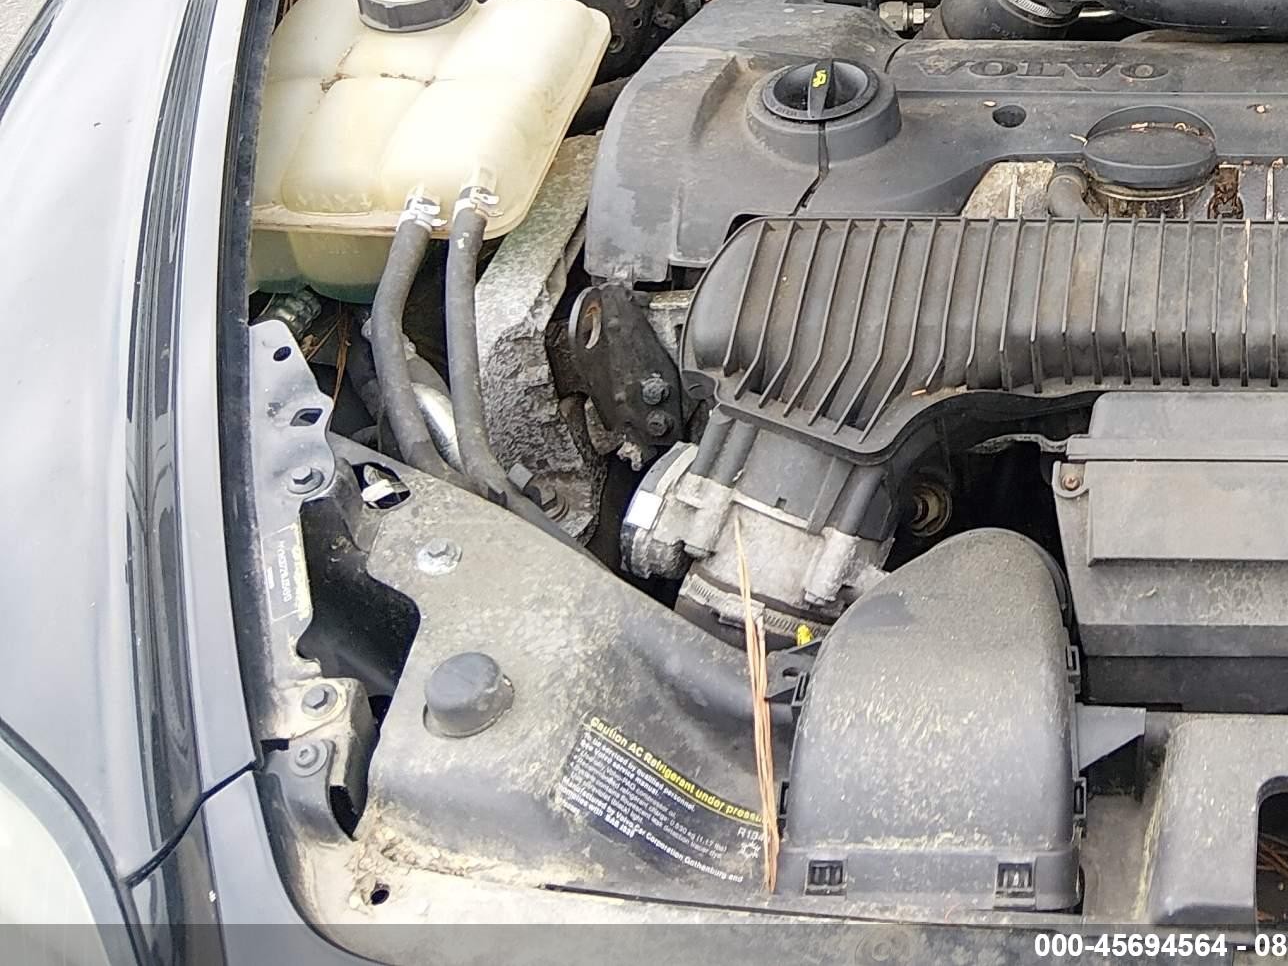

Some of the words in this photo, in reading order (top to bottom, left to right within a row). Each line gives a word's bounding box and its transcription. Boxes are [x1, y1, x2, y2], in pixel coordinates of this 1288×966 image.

[914, 60, 1169, 80] VOLVO
[590, 717, 628, 747] Caution
[628, 742, 644, 757] AC
[643, 752, 695, 793] Refrigerant
[695, 789, 725, 811] under
[594, 748, 612, 764] Volvo
[612, 761, 635, 779] service
[636, 769, 664, 790] qualified
[562, 775, 607, 810] Manufactured
[606, 805, 616, 817] by
[646, 832, 684, 861] Corporation
[684, 856, 727, 880] Gothenburg
[728, 873, 744, 883] and
